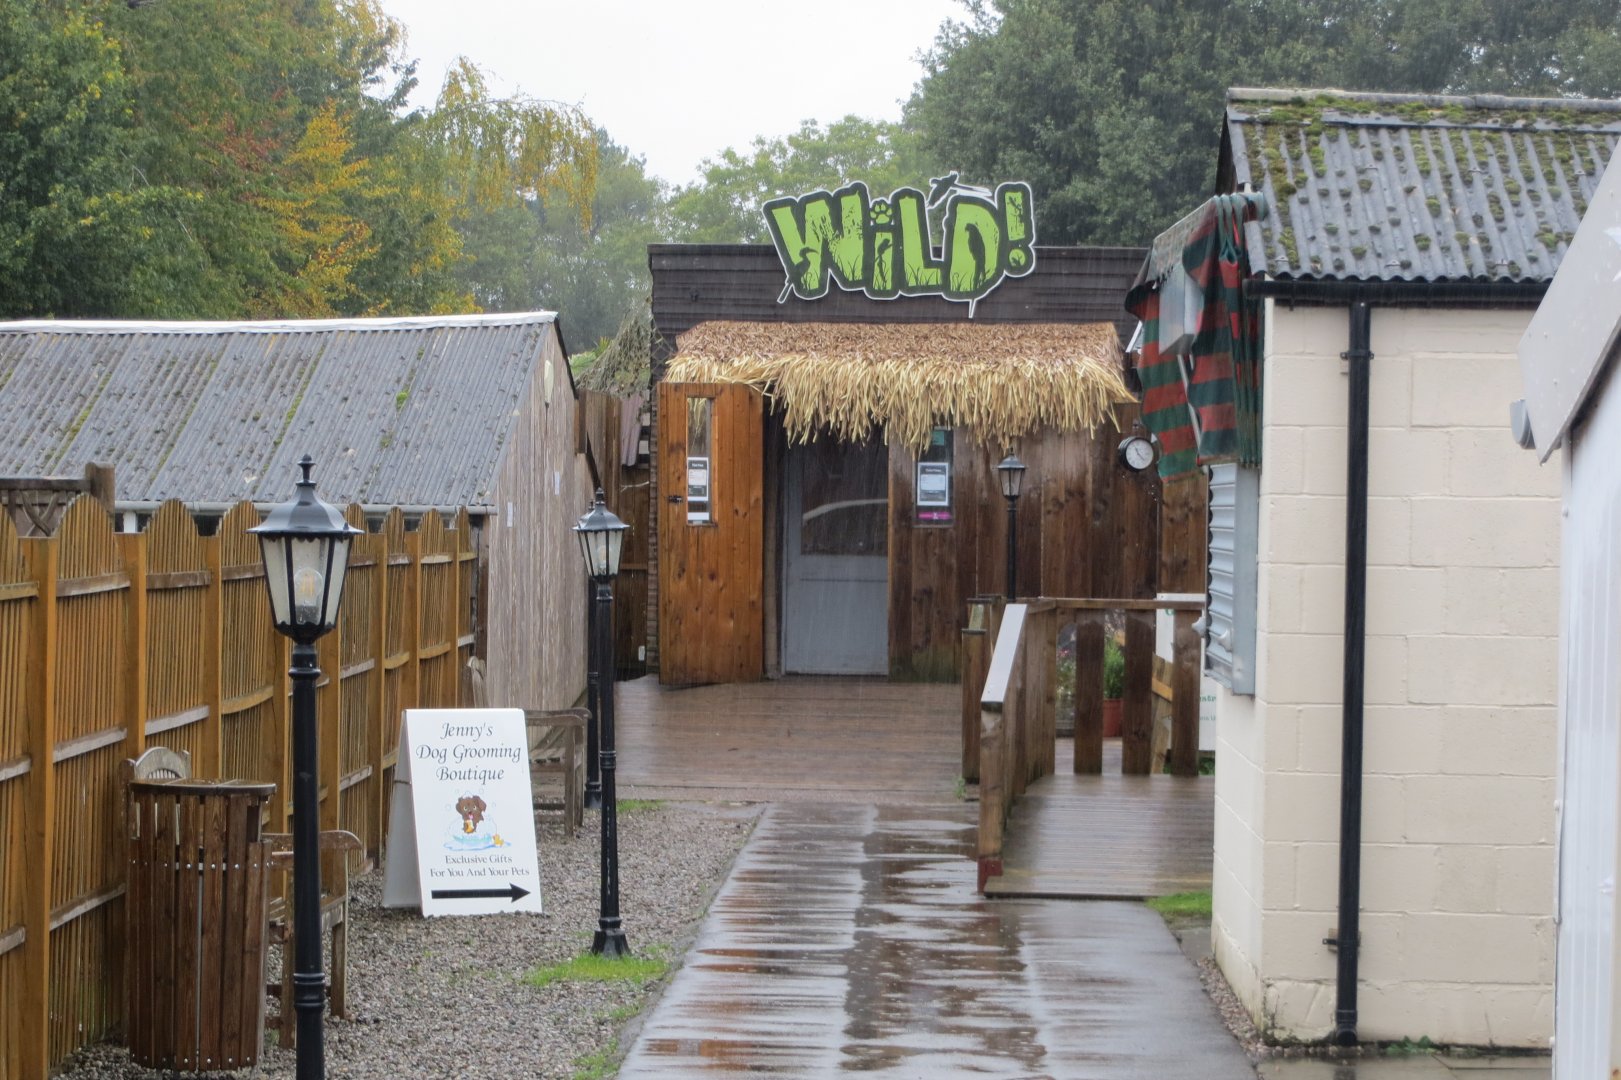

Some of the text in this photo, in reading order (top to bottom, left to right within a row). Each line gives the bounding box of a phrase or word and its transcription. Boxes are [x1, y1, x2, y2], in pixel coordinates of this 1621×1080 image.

[440, 722, 493, 742] Jenny's
[416, 742, 521, 764] Dog Grooming
[436, 765, 505, 785] Boutique
[445, 854, 513, 864] Exclusive Gifts
[430, 866, 530, 877] For You And Your Pets
